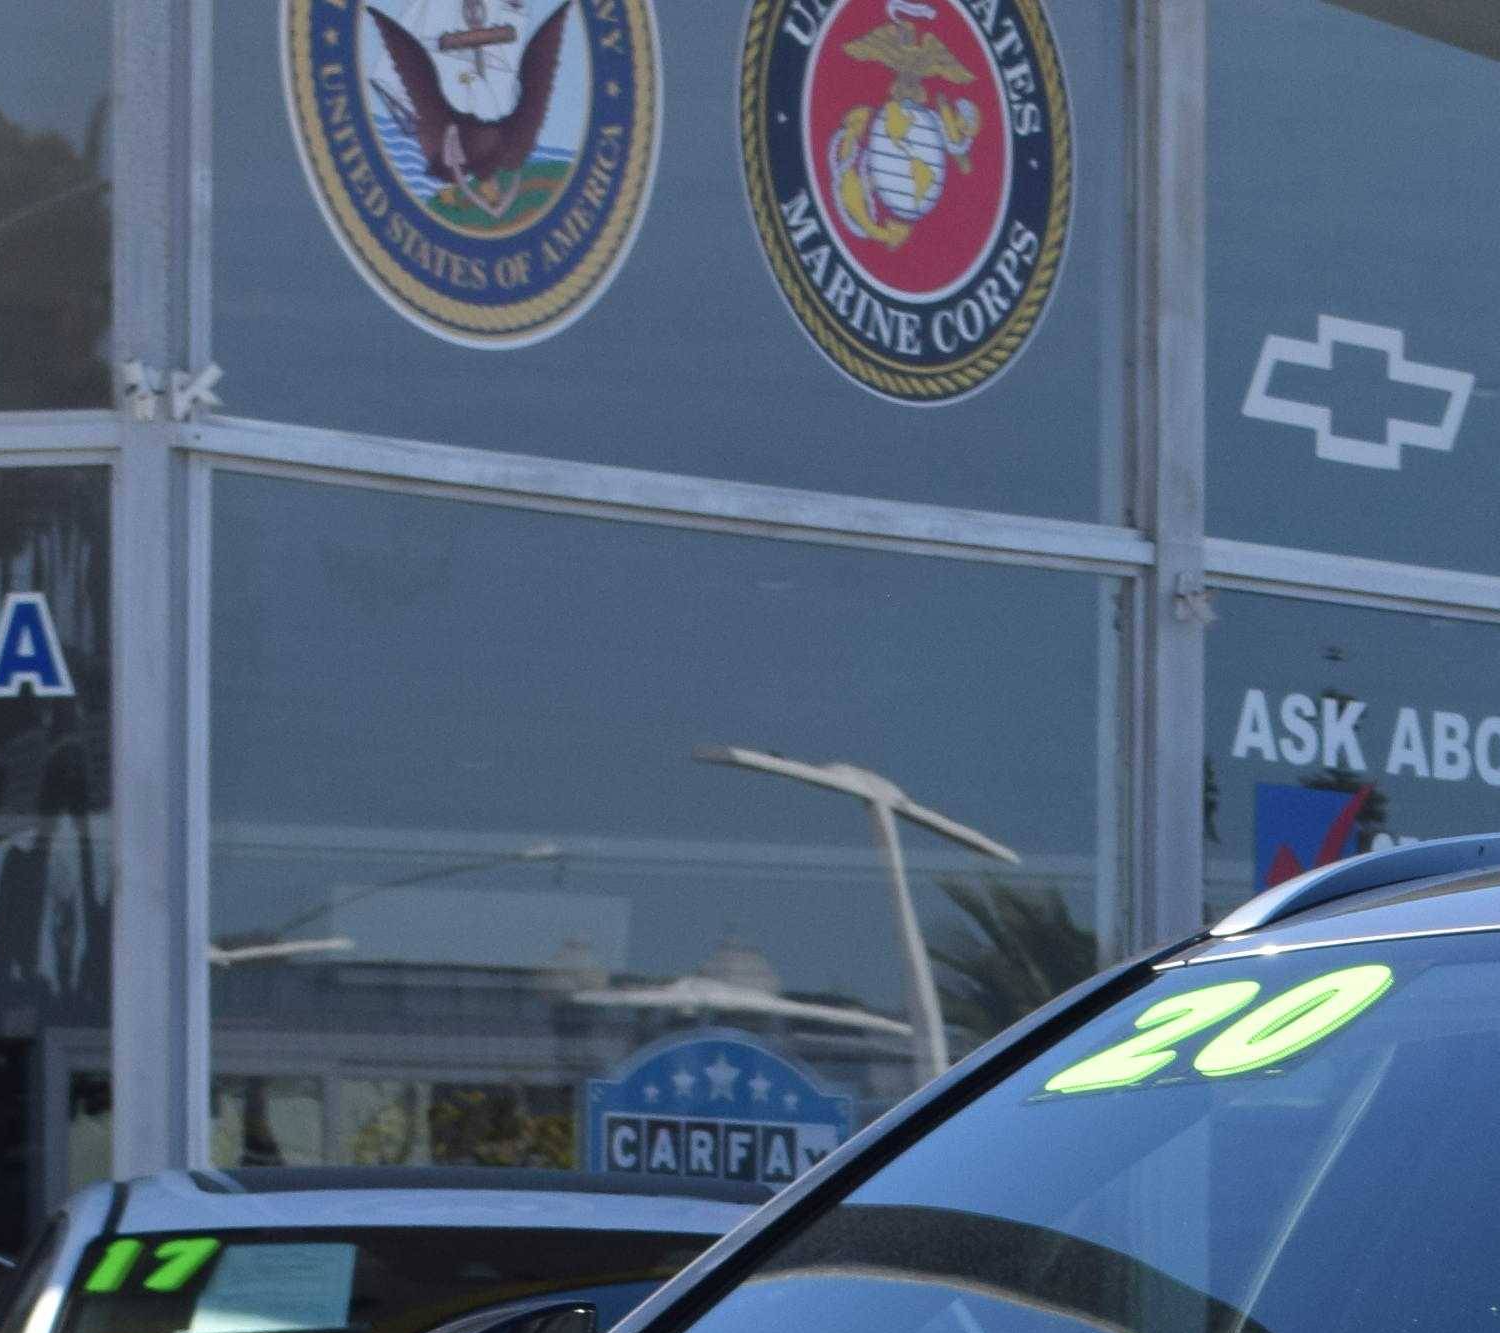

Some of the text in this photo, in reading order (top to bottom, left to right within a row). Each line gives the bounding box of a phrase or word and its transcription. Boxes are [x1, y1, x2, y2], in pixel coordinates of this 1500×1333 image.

[973, 0, 1042, 136] ATES
[321, 64, 624, 289] UNITED STATES OF AMERICA
[782, 191, 1040, 356] MARINE CORPS
[1232, 688, 1369, 771] ASK
[1044, 964, 1393, 1095] 20
[84, 1237, 221, 1294] 17
